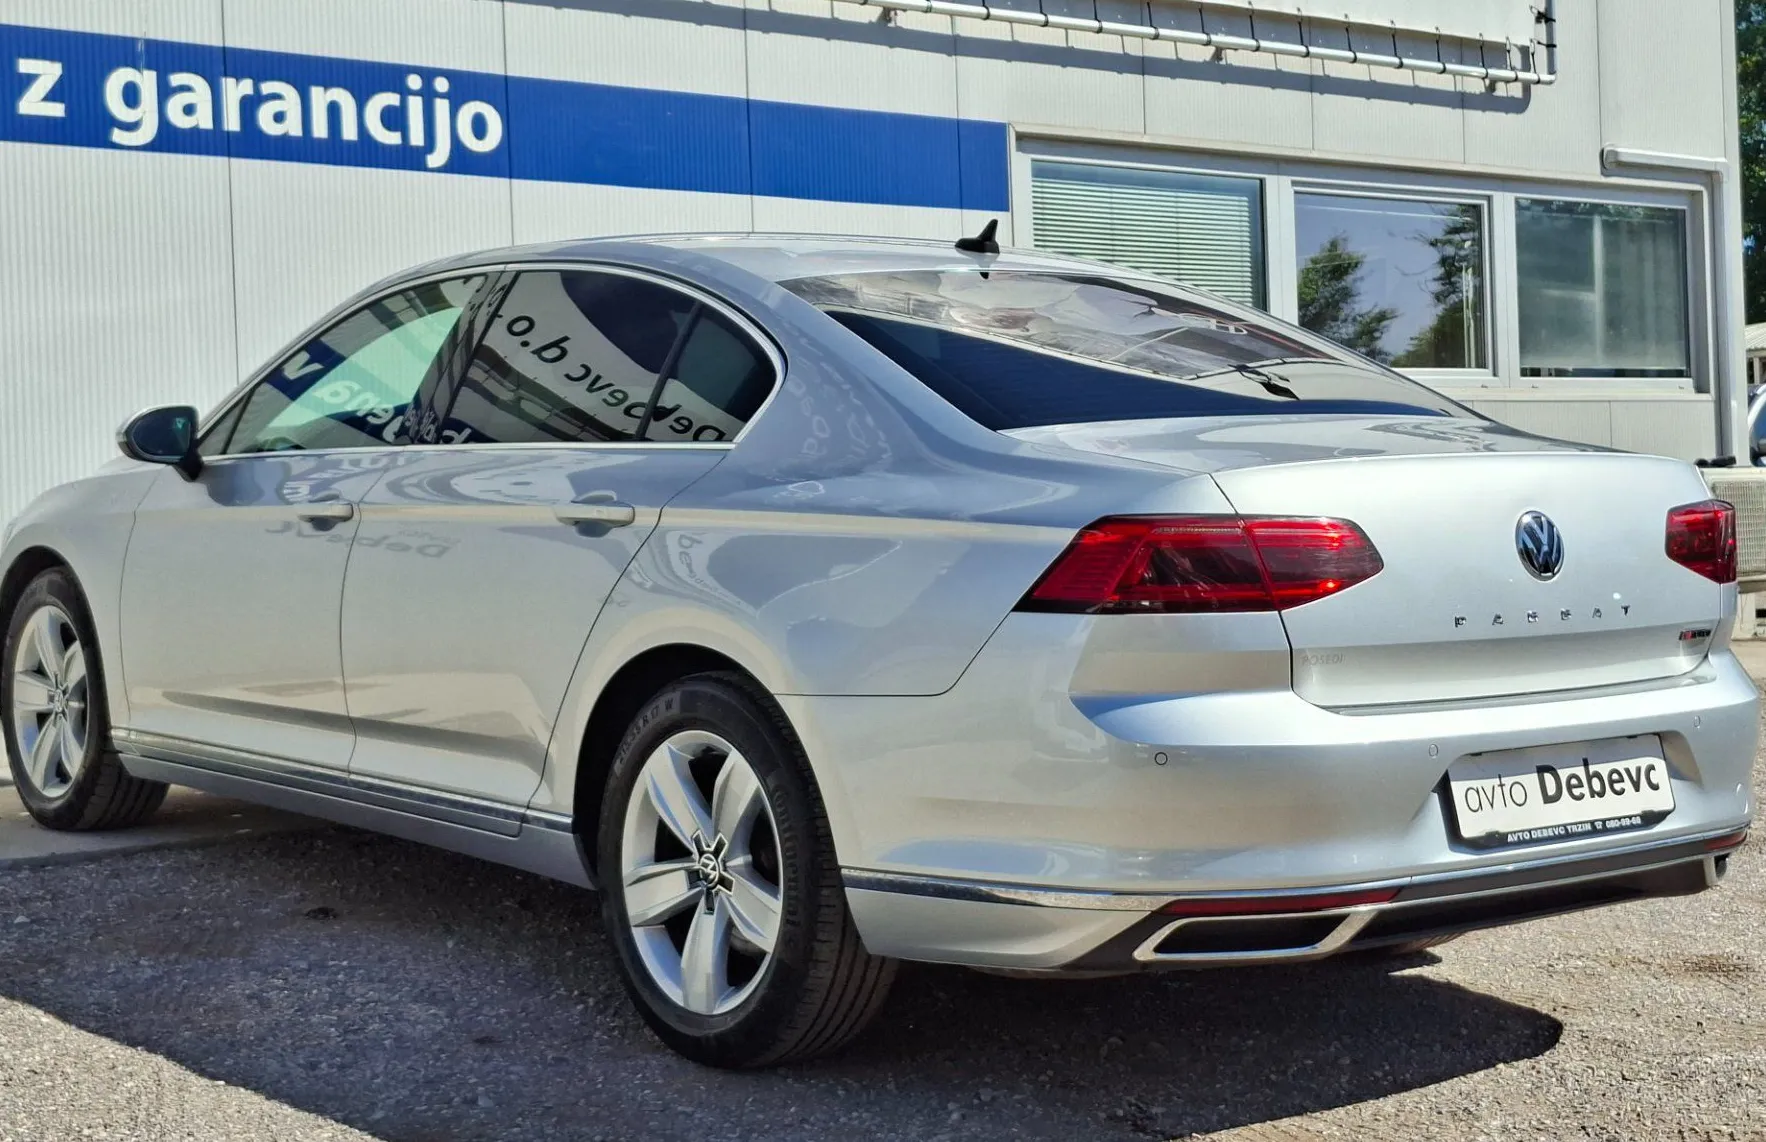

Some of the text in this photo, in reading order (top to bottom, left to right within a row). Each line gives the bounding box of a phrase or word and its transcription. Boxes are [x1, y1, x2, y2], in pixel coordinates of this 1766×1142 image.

[17, 58, 503, 168] z garancijo
[1454, 605, 1631, 628] PASSAT
[1464, 758, 1661, 813] avto Debevc
[1507, 831, 1530, 843] AVTO
[1531, 825, 1566, 839] DEBEVC
[1567, 822, 1592, 835] TRZIN
